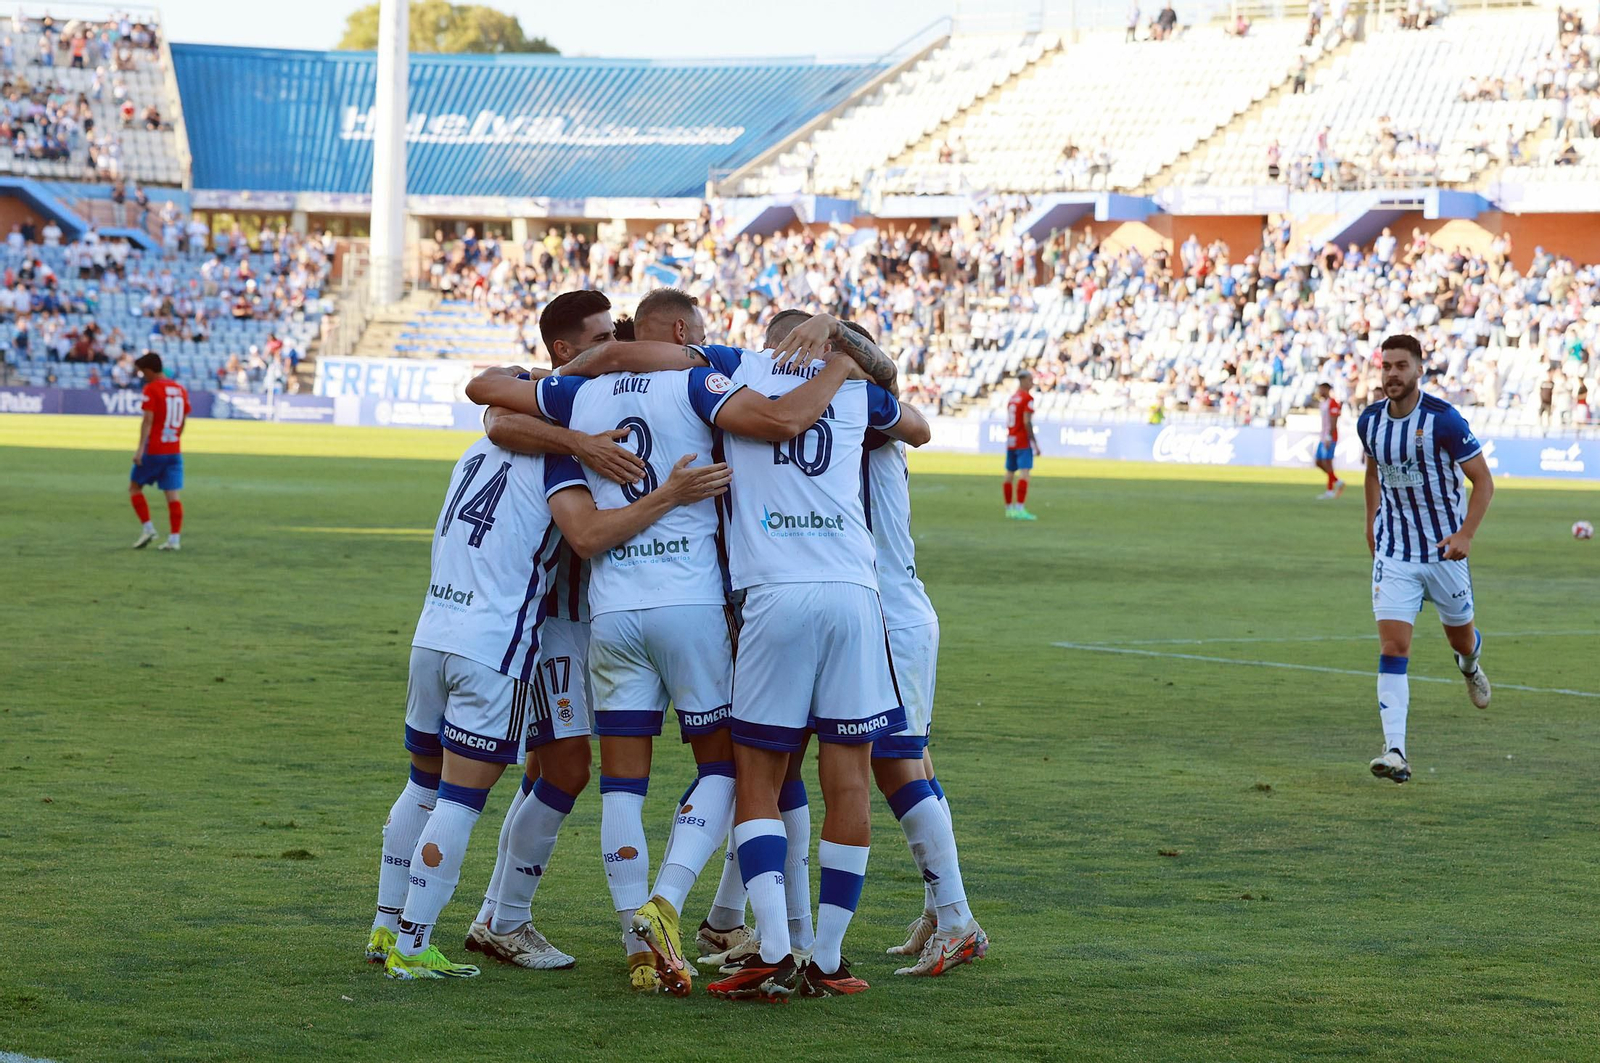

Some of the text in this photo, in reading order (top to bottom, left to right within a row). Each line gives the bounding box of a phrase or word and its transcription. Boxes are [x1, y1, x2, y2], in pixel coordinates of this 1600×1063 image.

[344, 105, 568, 143] Helva
[321, 362, 437, 401] FRENTE
[164, 396, 185, 428] 10
[441, 453, 512, 549] 14
[768, 511, 844, 531] Onubat
[611, 536, 690, 560] Onubat
[1374, 559, 1384, 583] 8
[543, 656, 571, 695] 17
[444, 724, 497, 752] ROMERO
[837, 715, 889, 735] ROMERO
[384, 854, 412, 868] 1889
[603, 850, 639, 863] 188
